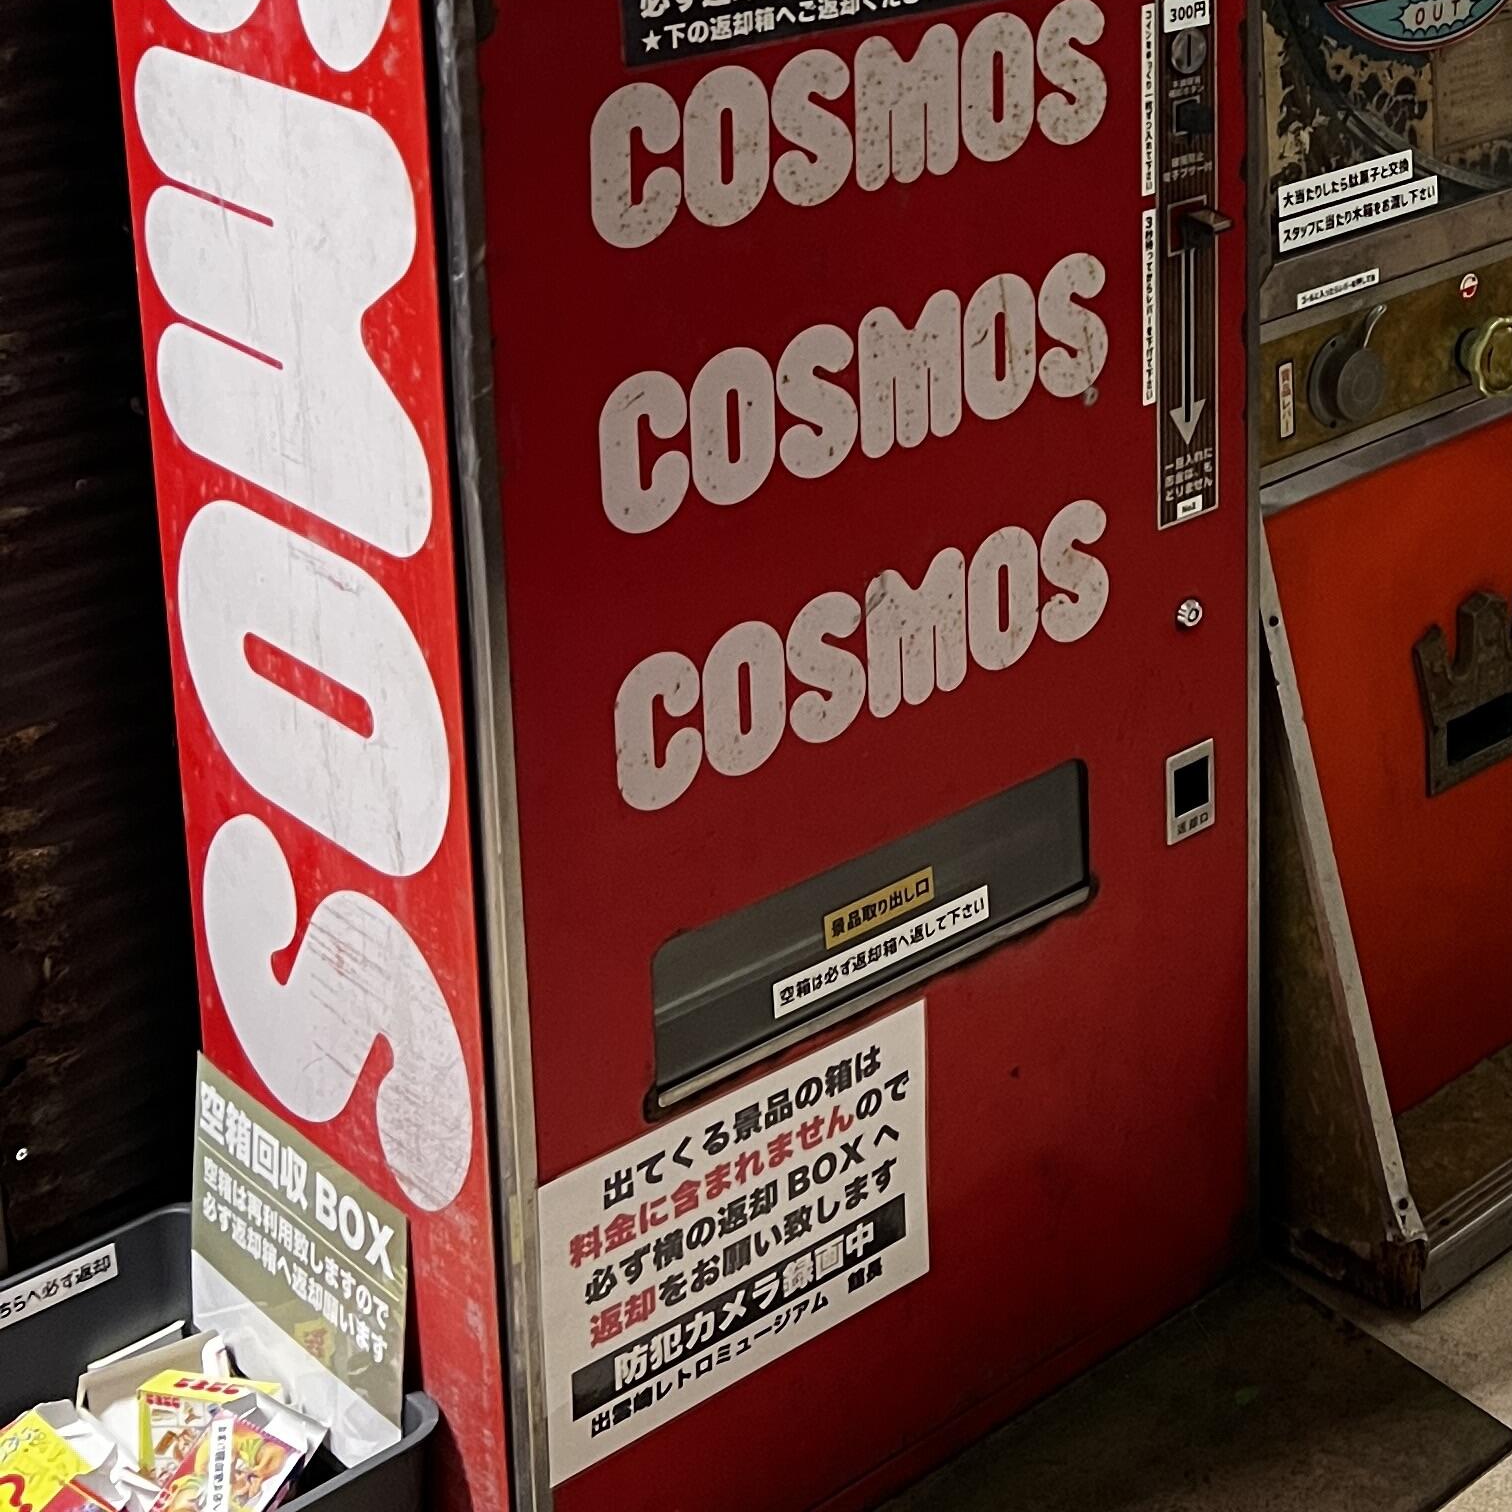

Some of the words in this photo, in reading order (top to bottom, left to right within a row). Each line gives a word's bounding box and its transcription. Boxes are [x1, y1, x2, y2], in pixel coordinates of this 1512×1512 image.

[1170, 1, 1206, 23] 300円
[598, 251, 1109, 535] COSMOS
[614, 498, 1110, 812] COSMOS
[779, 896, 986, 1007] 空箱は必ず返却箱へ返して下さい
[831, 876, 931, 940] 景品取り出し口
[200, 1081, 309, 1212] 空箱回収
[315, 1172, 395, 1281] BOX
[569, 1070, 909, 1268] 料金に含まれませんので
[603, 1045, 881, 1210] 出てくる景品の箱は
[202, 1191, 388, 1363] 必ず返却箱へ返却願います
[203, 1155, 390, 1330] 空箱は再利用致しますので
[584, 1187, 777, 1305] 必ず横の返却
[788, 1136, 864, 1206] BOX
[589, 1157, 898, 1350] 返却をお願い致します
[613, 1222, 876, 1392] 防犯カメラ録画中
